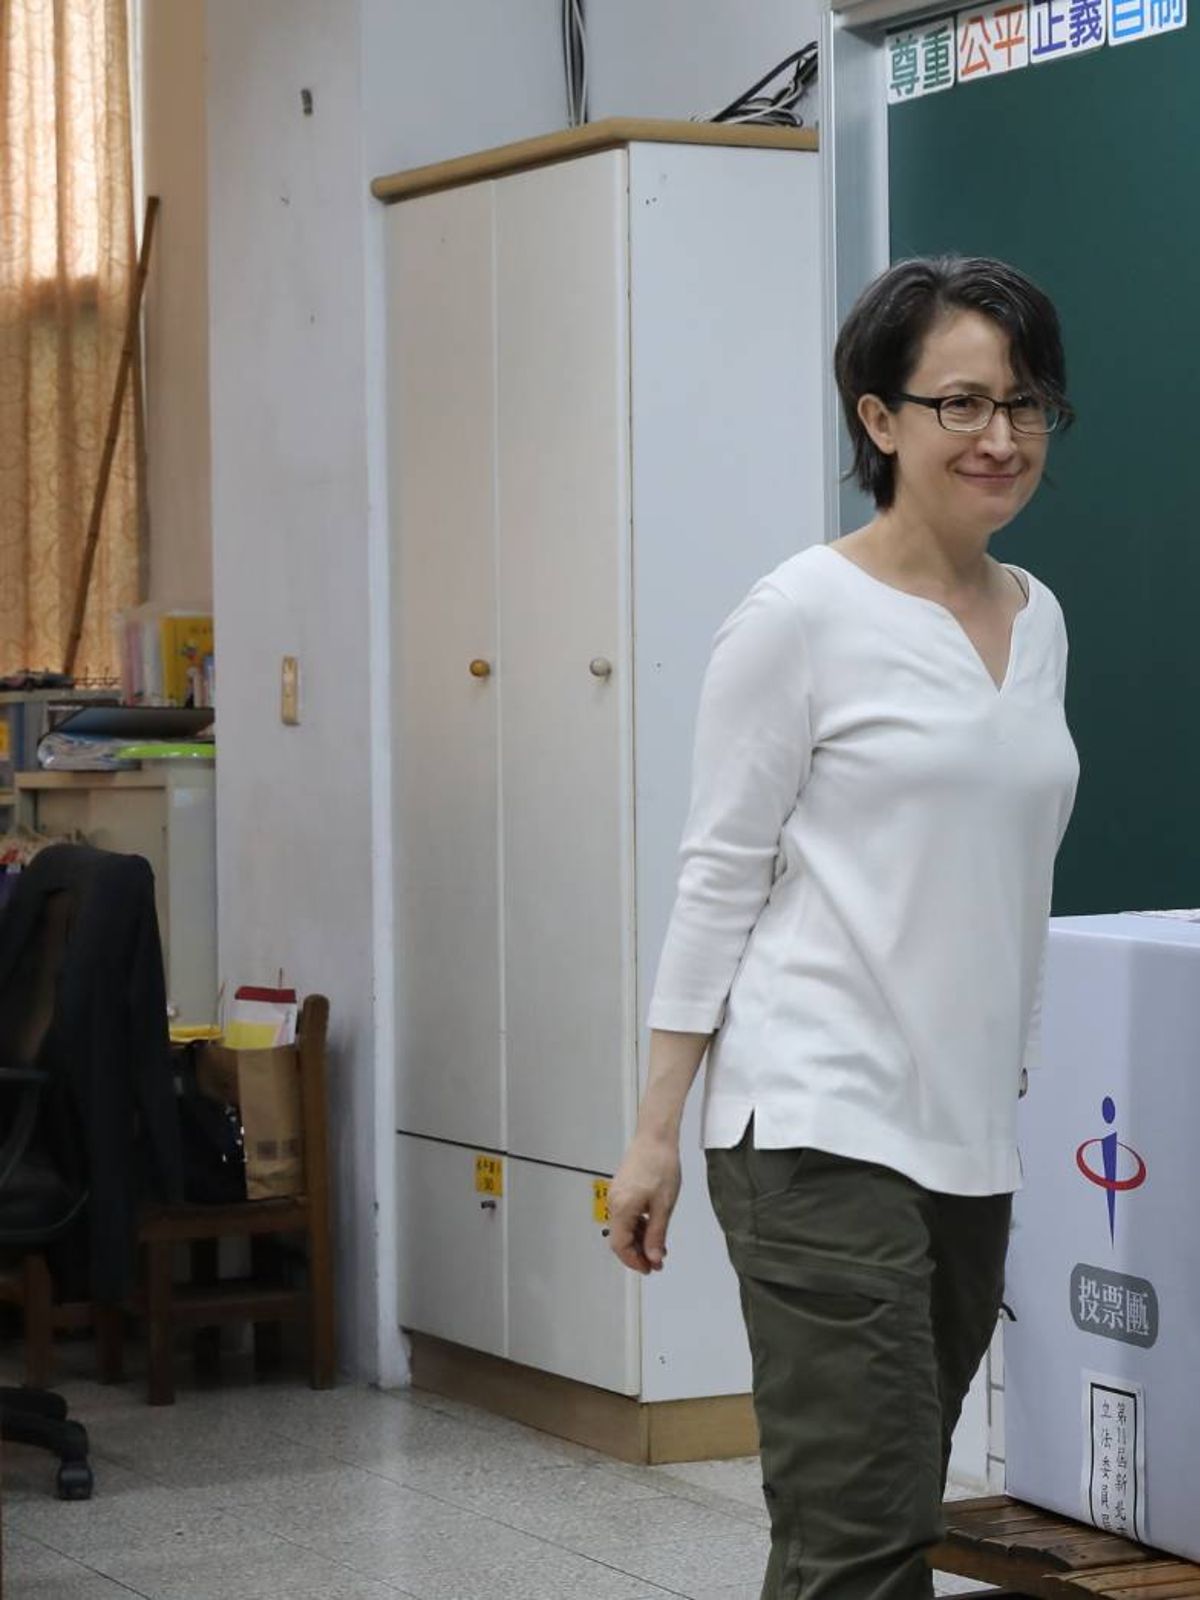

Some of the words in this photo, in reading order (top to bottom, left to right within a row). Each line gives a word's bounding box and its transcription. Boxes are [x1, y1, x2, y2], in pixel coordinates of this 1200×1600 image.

[890, 25, 952, 97] 尊重
[960, 4, 1025, 77] 公平
[1032, 0, 1102, 56] 正義
[1078, 1275, 1149, 1336] 投票匭
